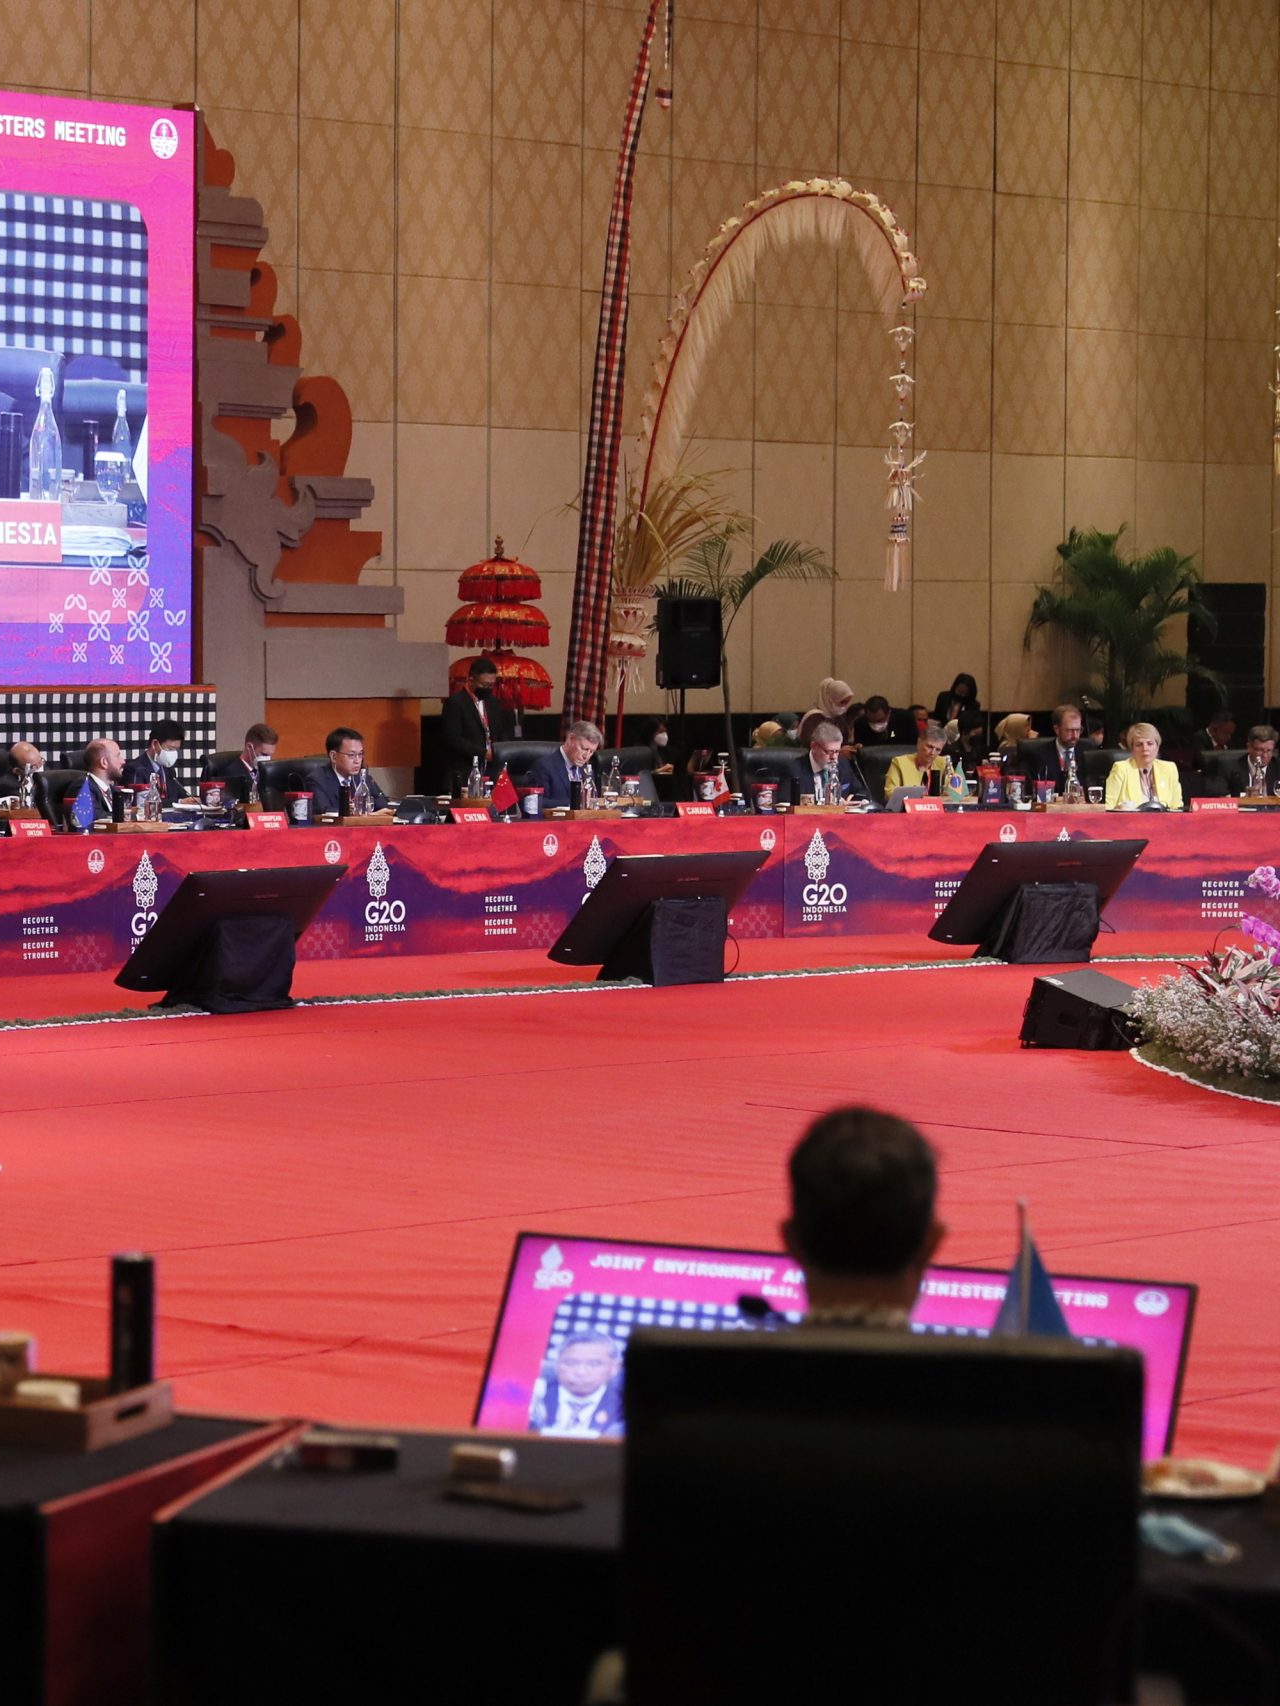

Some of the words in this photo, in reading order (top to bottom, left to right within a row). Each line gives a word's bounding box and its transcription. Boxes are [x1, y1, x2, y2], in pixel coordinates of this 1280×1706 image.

[55, 121, 126, 147] MEETING
[686, 806, 712, 815] CANADA
[464, 813, 487, 823] CHINA
[803, 883, 847, 905] G20
[485, 895, 513, 903] RECOVER
[365, 900, 406, 924] G20
[803, 906, 847, 914] INDONESIA
[23, 916, 54, 925] RECOVER
[131, 912, 158, 936] G2
[485, 918, 513, 926] RECOVER
[23, 925, 59, 935] TOGETHER
[365, 924, 406, 933] INDONESIA
[485, 927, 517, 935] STRONGER
[23, 941, 54, 950] RECOVER
[23, 950, 59, 960] STRONGER
[590, 1254, 645, 1271] JOINT
[653, 1258, 774, 1281] ENVIRONMENT
